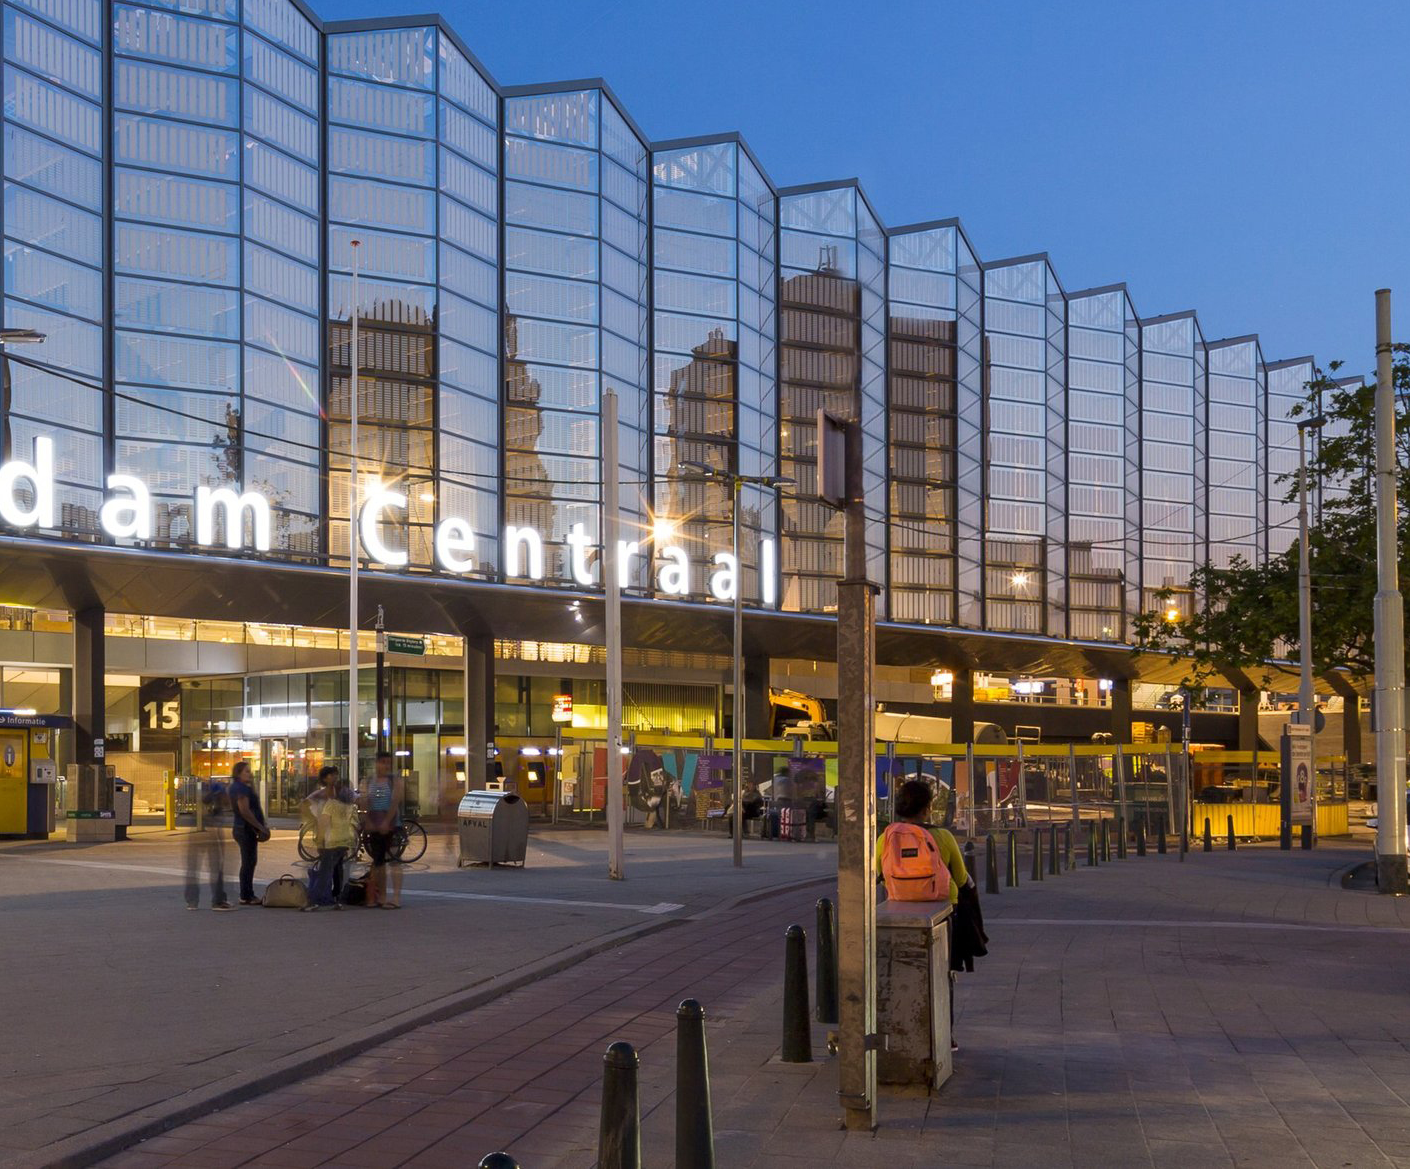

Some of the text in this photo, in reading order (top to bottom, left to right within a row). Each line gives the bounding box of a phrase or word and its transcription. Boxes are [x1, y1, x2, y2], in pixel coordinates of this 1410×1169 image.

[358, 489, 777, 606] Centraal
[7, 715, 46, 726] Informatie
[143, 701, 179, 730] 15
[462, 819, 487, 828] AFVAL
